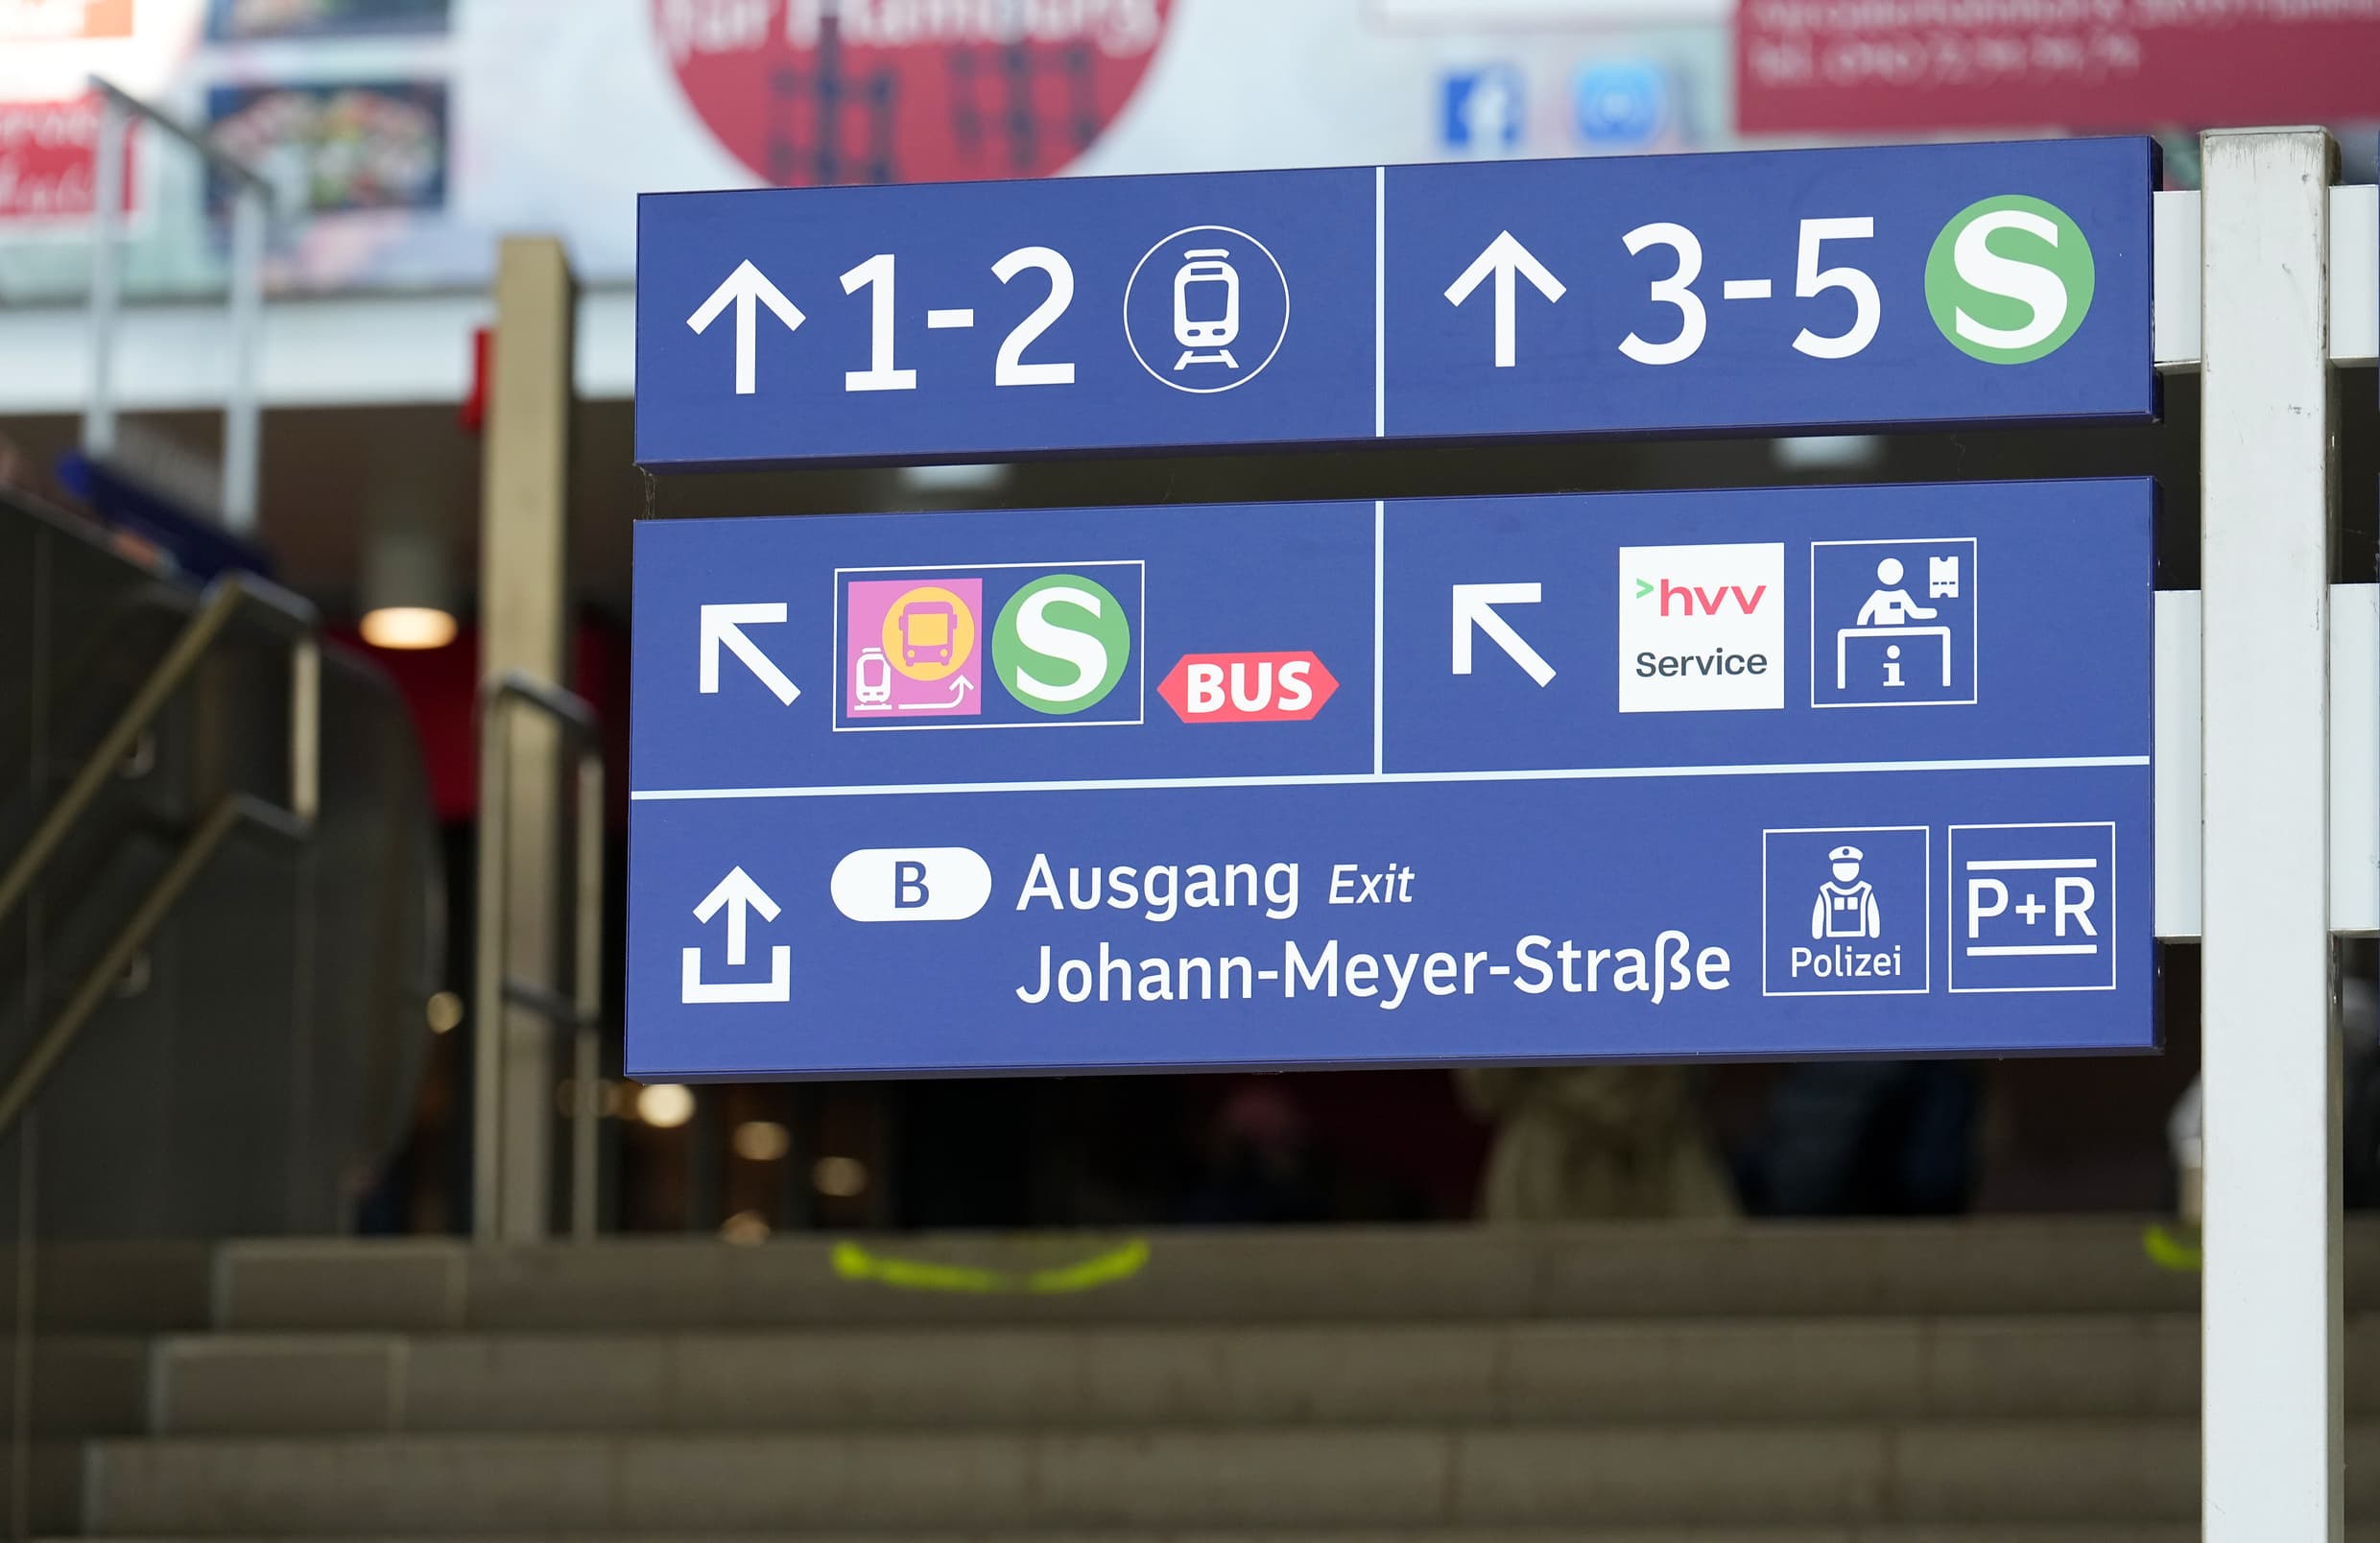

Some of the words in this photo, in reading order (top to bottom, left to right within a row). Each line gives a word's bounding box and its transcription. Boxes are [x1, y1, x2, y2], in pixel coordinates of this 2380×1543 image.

[1618, 216, 1881, 366] 3-5
[1953, 209, 2069, 349] S
[840, 246, 1075, 392] 1-2
[1015, 586, 1107, 702] S
[1635, 647, 1768, 677] Service
[1187, 660, 1313, 714] BUS
[894, 861, 930, 909] B
[1015, 853, 1298, 922] Ausgang
[1328, 863, 1416, 905] Exit
[1967, 875, 2098, 938] P+R
[1015, 929, 1730, 1009] Johann-Meyer-Straße
[1792, 943, 1902, 978] Polizei
